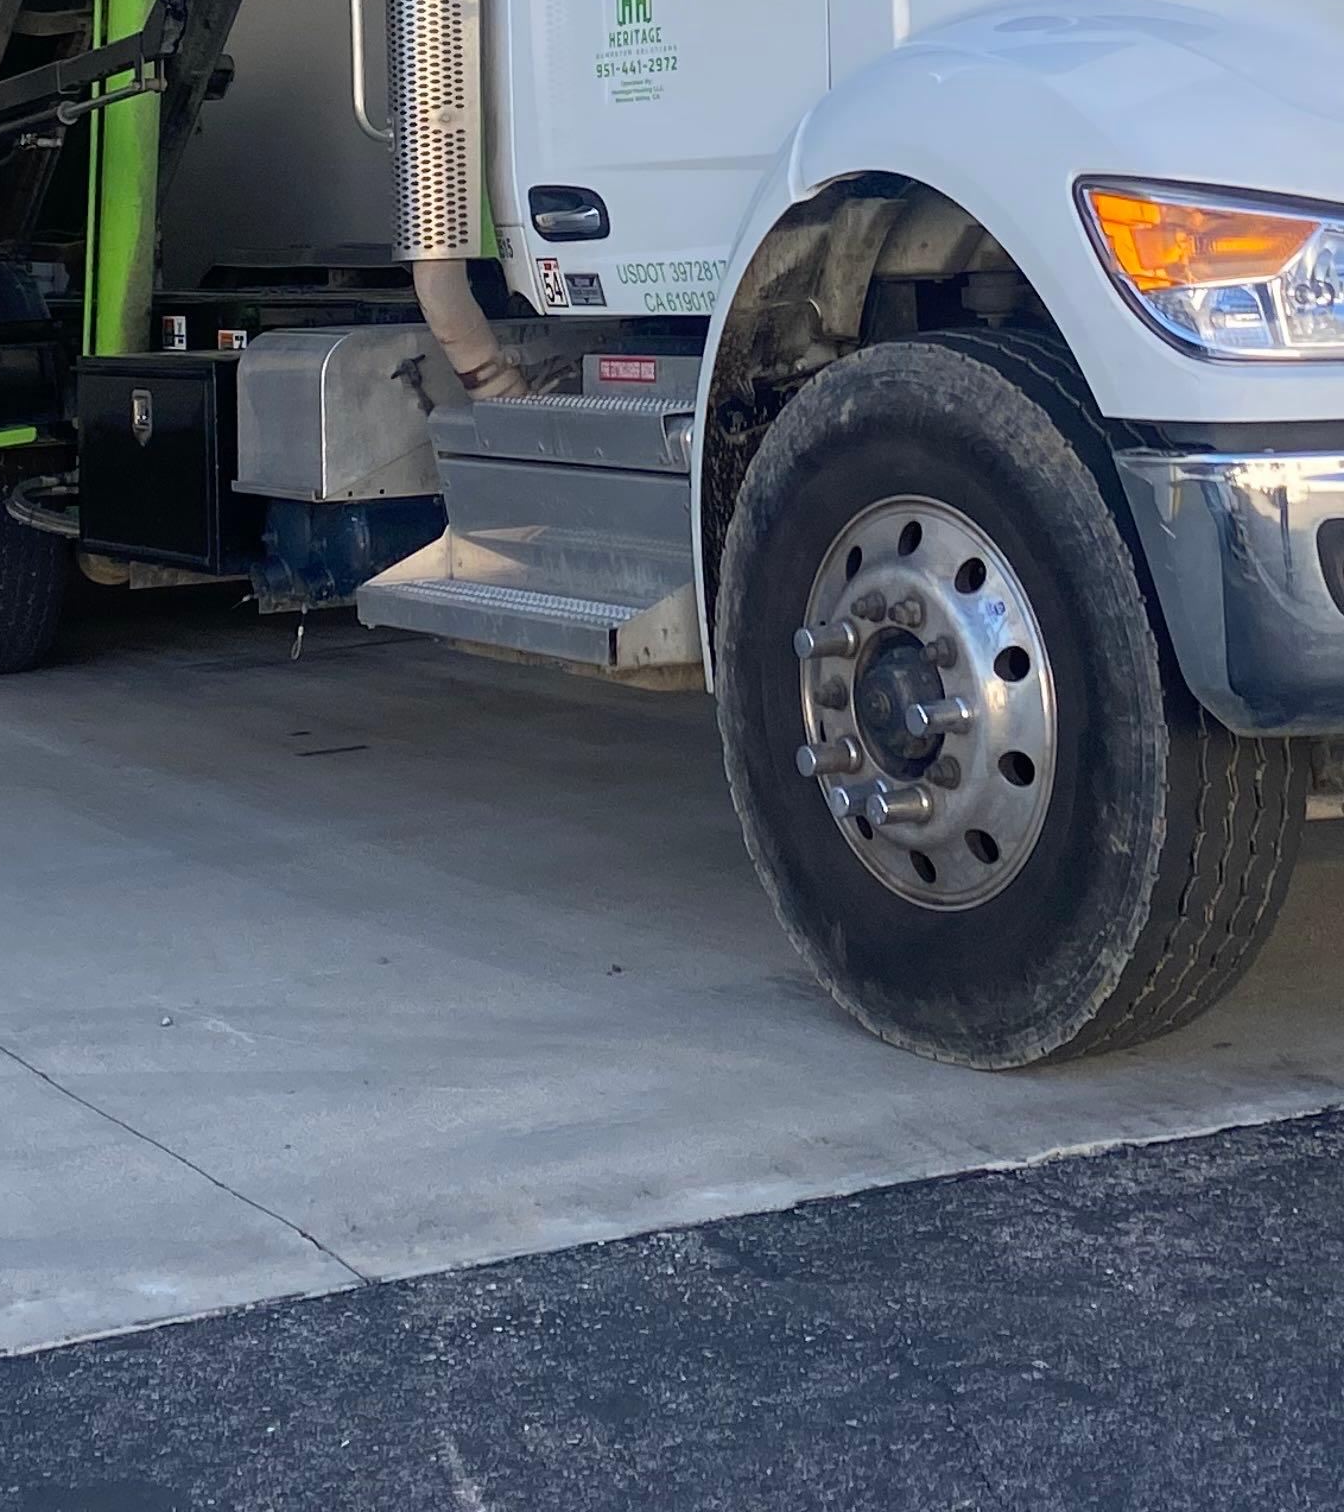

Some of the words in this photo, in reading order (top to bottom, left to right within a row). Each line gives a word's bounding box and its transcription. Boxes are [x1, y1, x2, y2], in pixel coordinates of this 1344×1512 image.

[608, 26, 663, 49] HERITAGE
[595, 55, 678, 79] 951-441-2972
[616, 262, 665, 284] USDOT
[669, 259, 727, 283] 3972817
[543, 272, 565, 304] 54
[643, 292, 666, 313] CA
